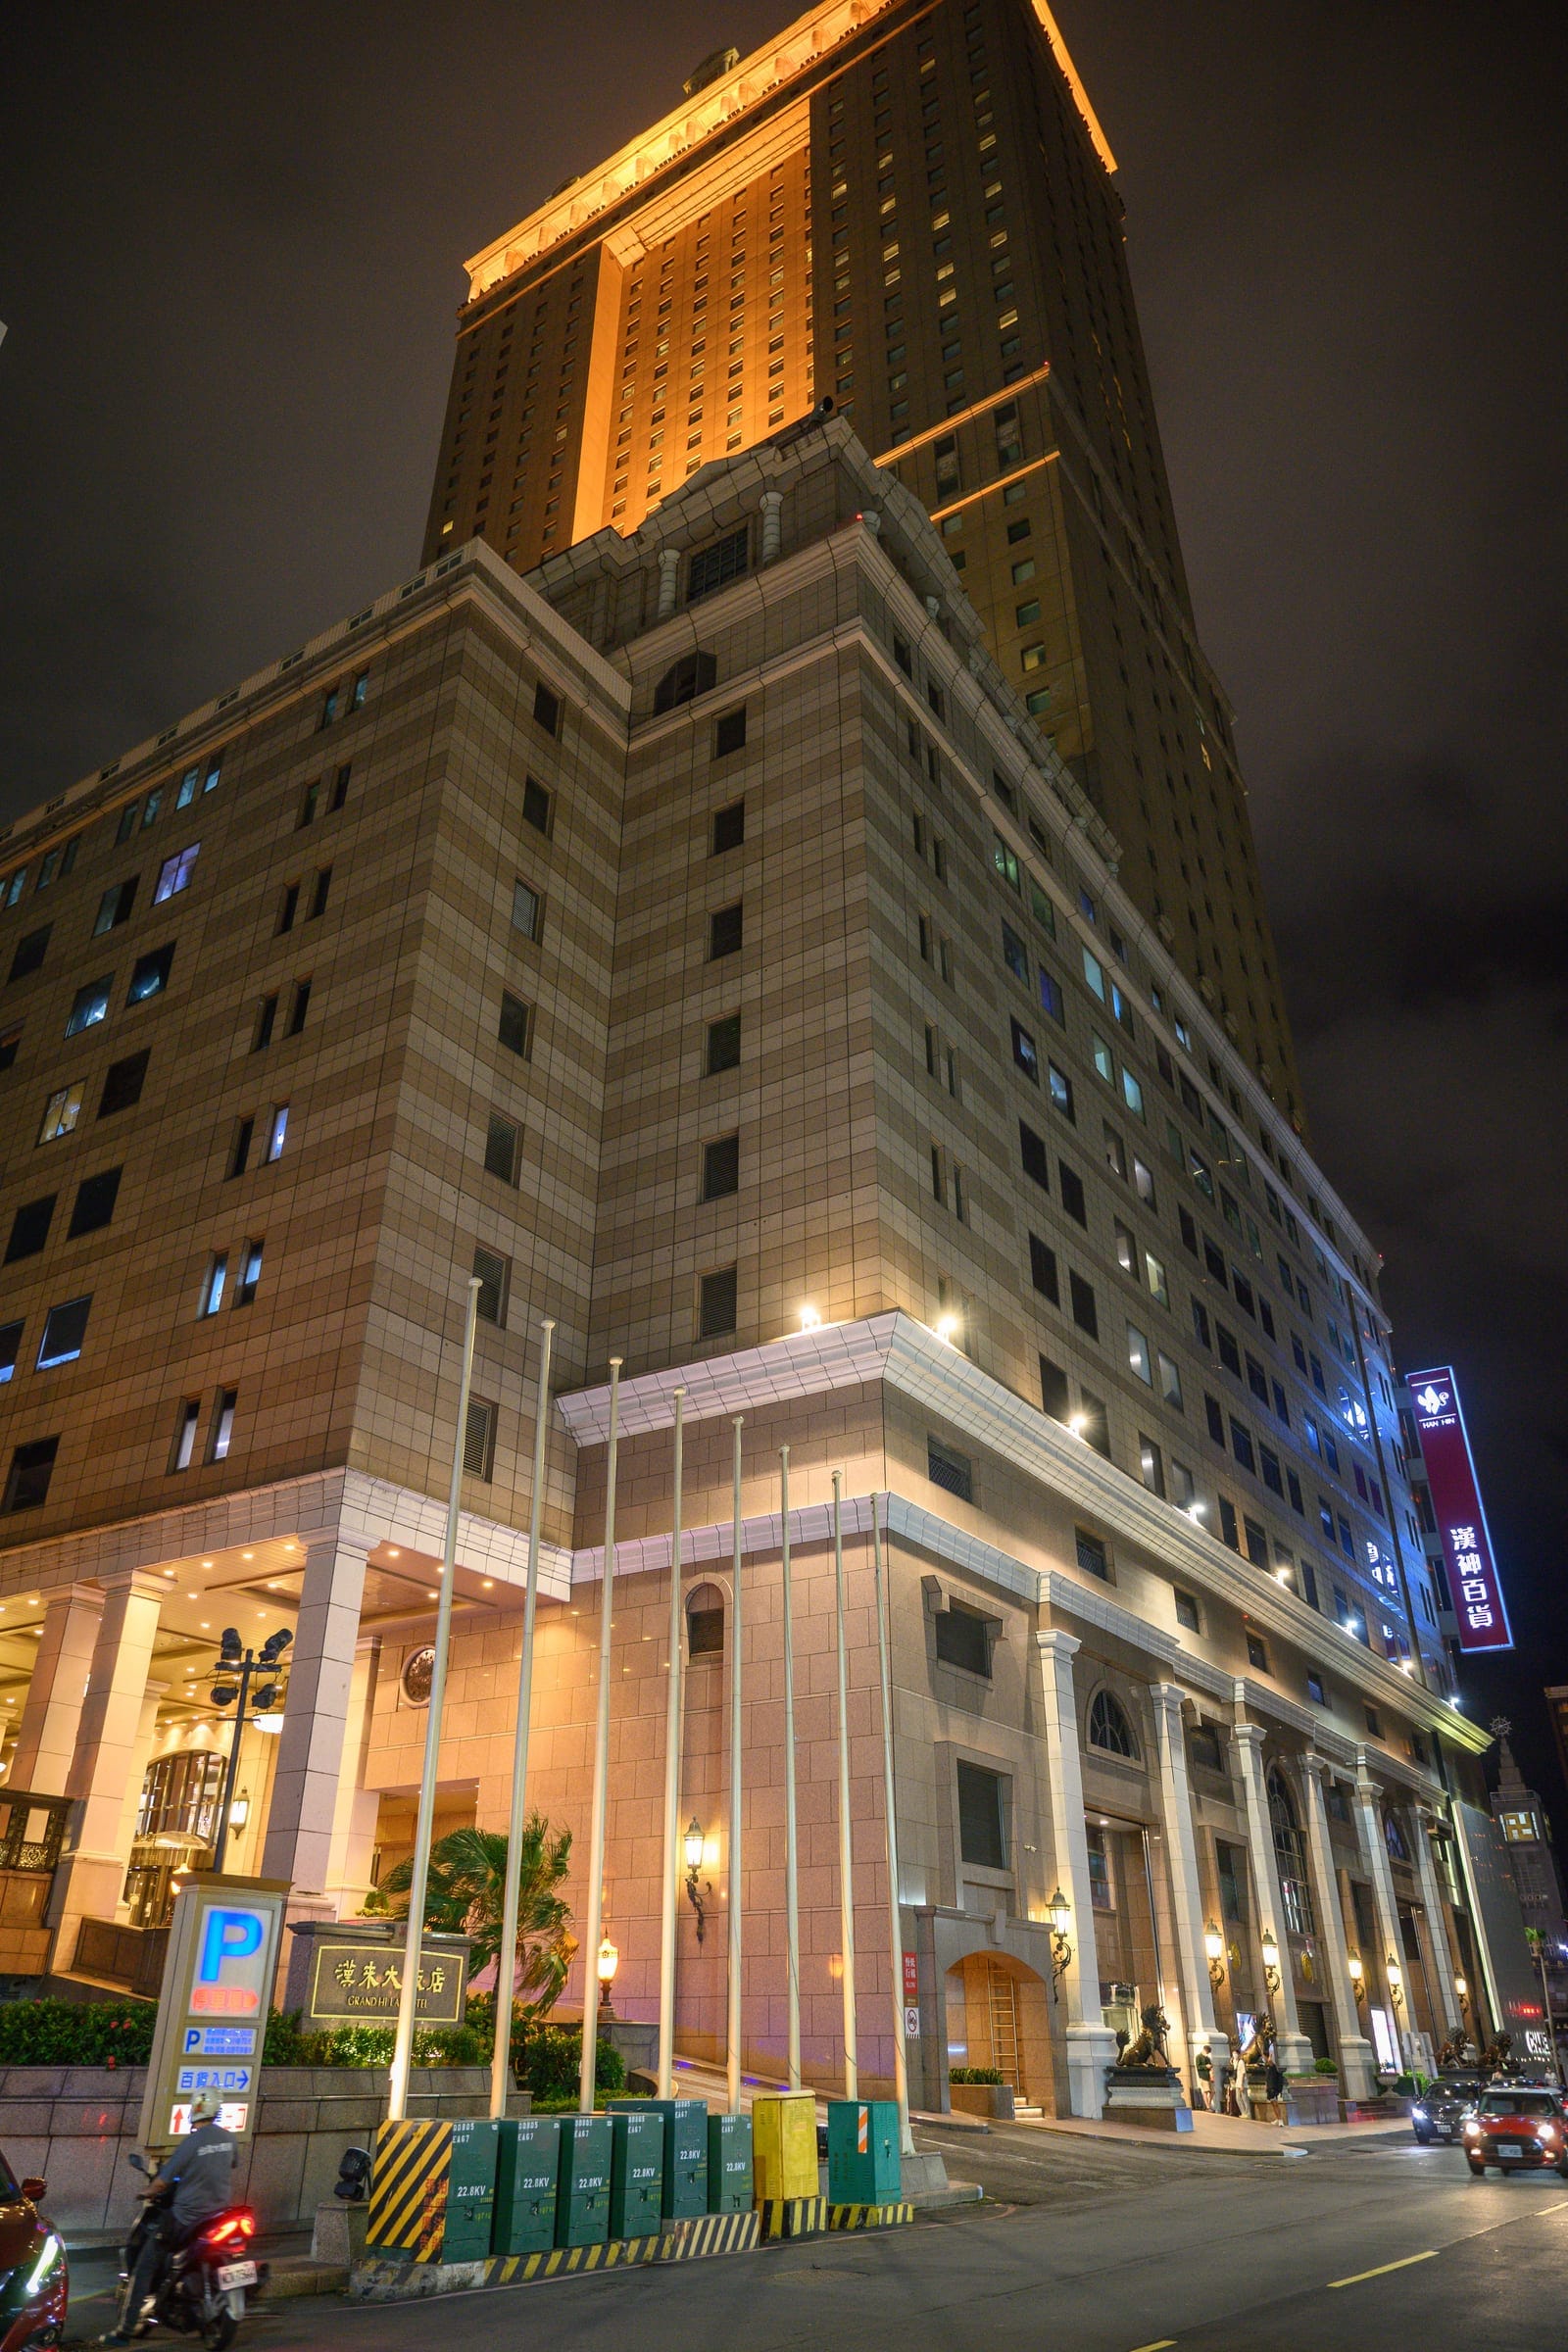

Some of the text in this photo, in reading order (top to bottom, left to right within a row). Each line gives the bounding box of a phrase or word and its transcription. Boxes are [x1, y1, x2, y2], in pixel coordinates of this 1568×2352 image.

[1449, 1526, 1494, 1629] 漢神百貨
[199, 1910, 264, 1982] P
[347, 1994, 377, 2007] GRAND
[184, 2030, 201, 2053] P
[180, 2071, 236, 2088] 百貨入口
[632, 2167, 656, 2179] 22.8KV
[523, 2178, 550, 2189] 22.8KV
[578, 2177, 603, 2188] 22.8KV
[457, 2184, 486, 2197] 22.8KV
